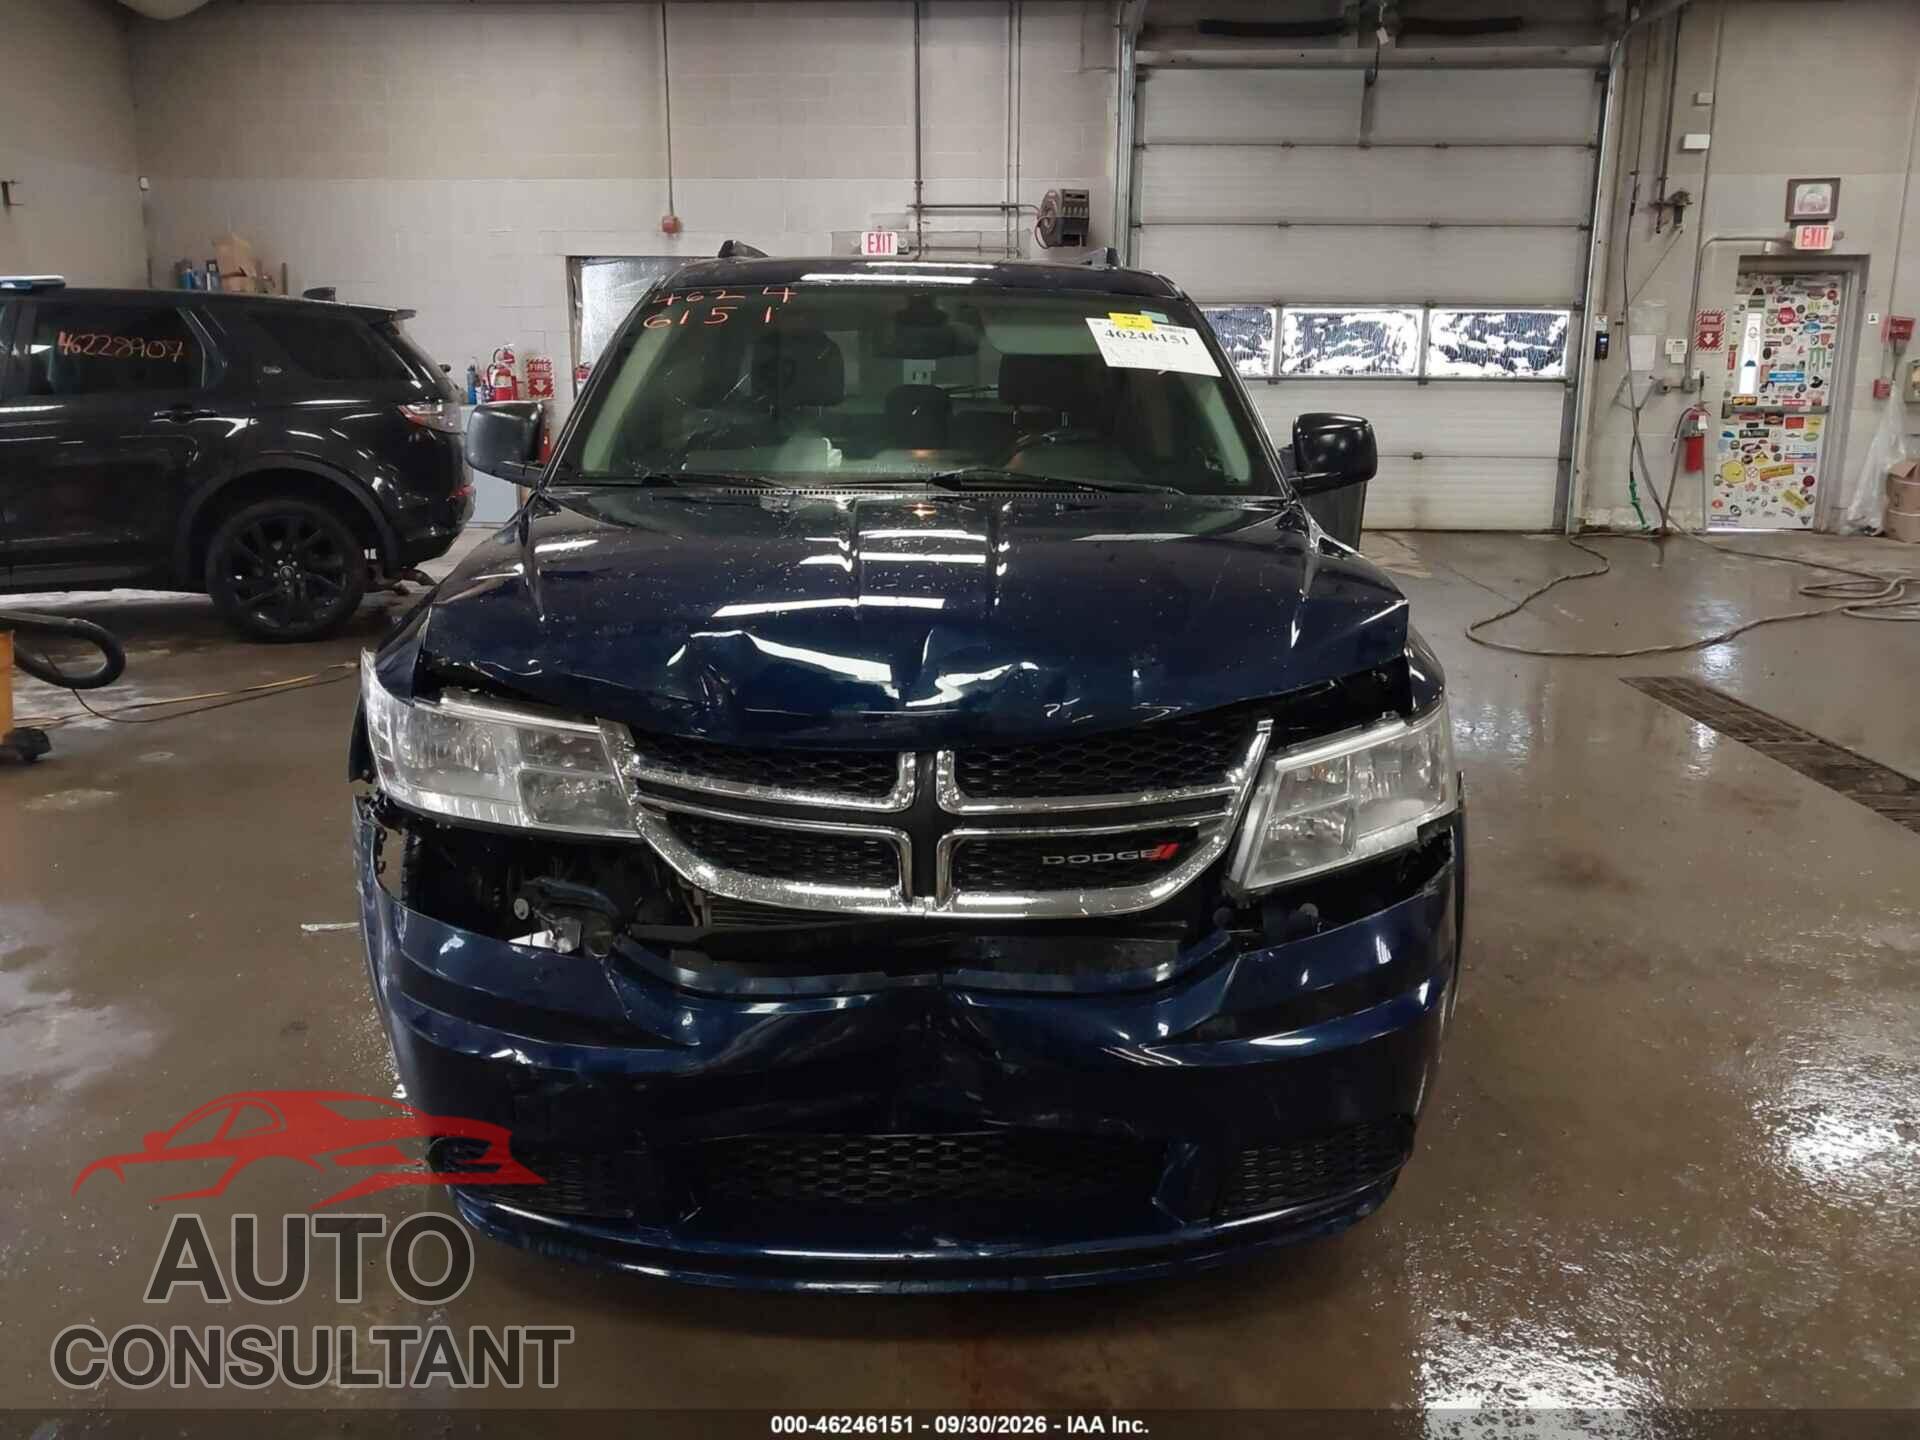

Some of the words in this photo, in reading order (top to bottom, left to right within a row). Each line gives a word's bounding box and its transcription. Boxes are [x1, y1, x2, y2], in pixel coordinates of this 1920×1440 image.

[867, 232, 893, 254] EXIT
[1801, 226, 1830, 248] EXIT
[1105, 328, 1190, 346] 46246151
[529, 362, 551, 371] FIRE
[1041, 849, 1160, 865] DODGE
